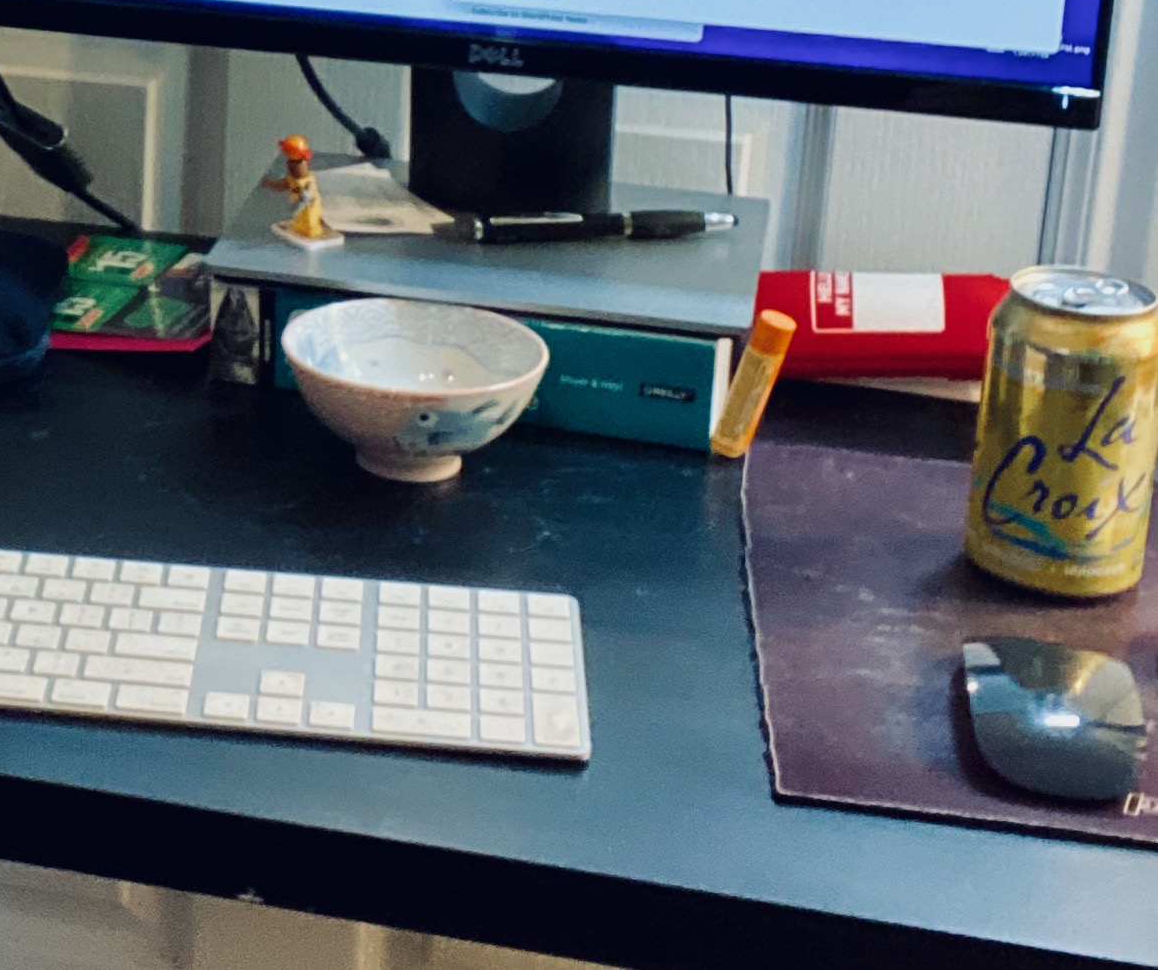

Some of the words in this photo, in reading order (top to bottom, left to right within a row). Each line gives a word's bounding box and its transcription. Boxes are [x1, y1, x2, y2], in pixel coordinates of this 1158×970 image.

[468, 44, 524, 68] DELL
[1056, 376, 1136, 471] La
[982, 435, 1146, 540] Croix
